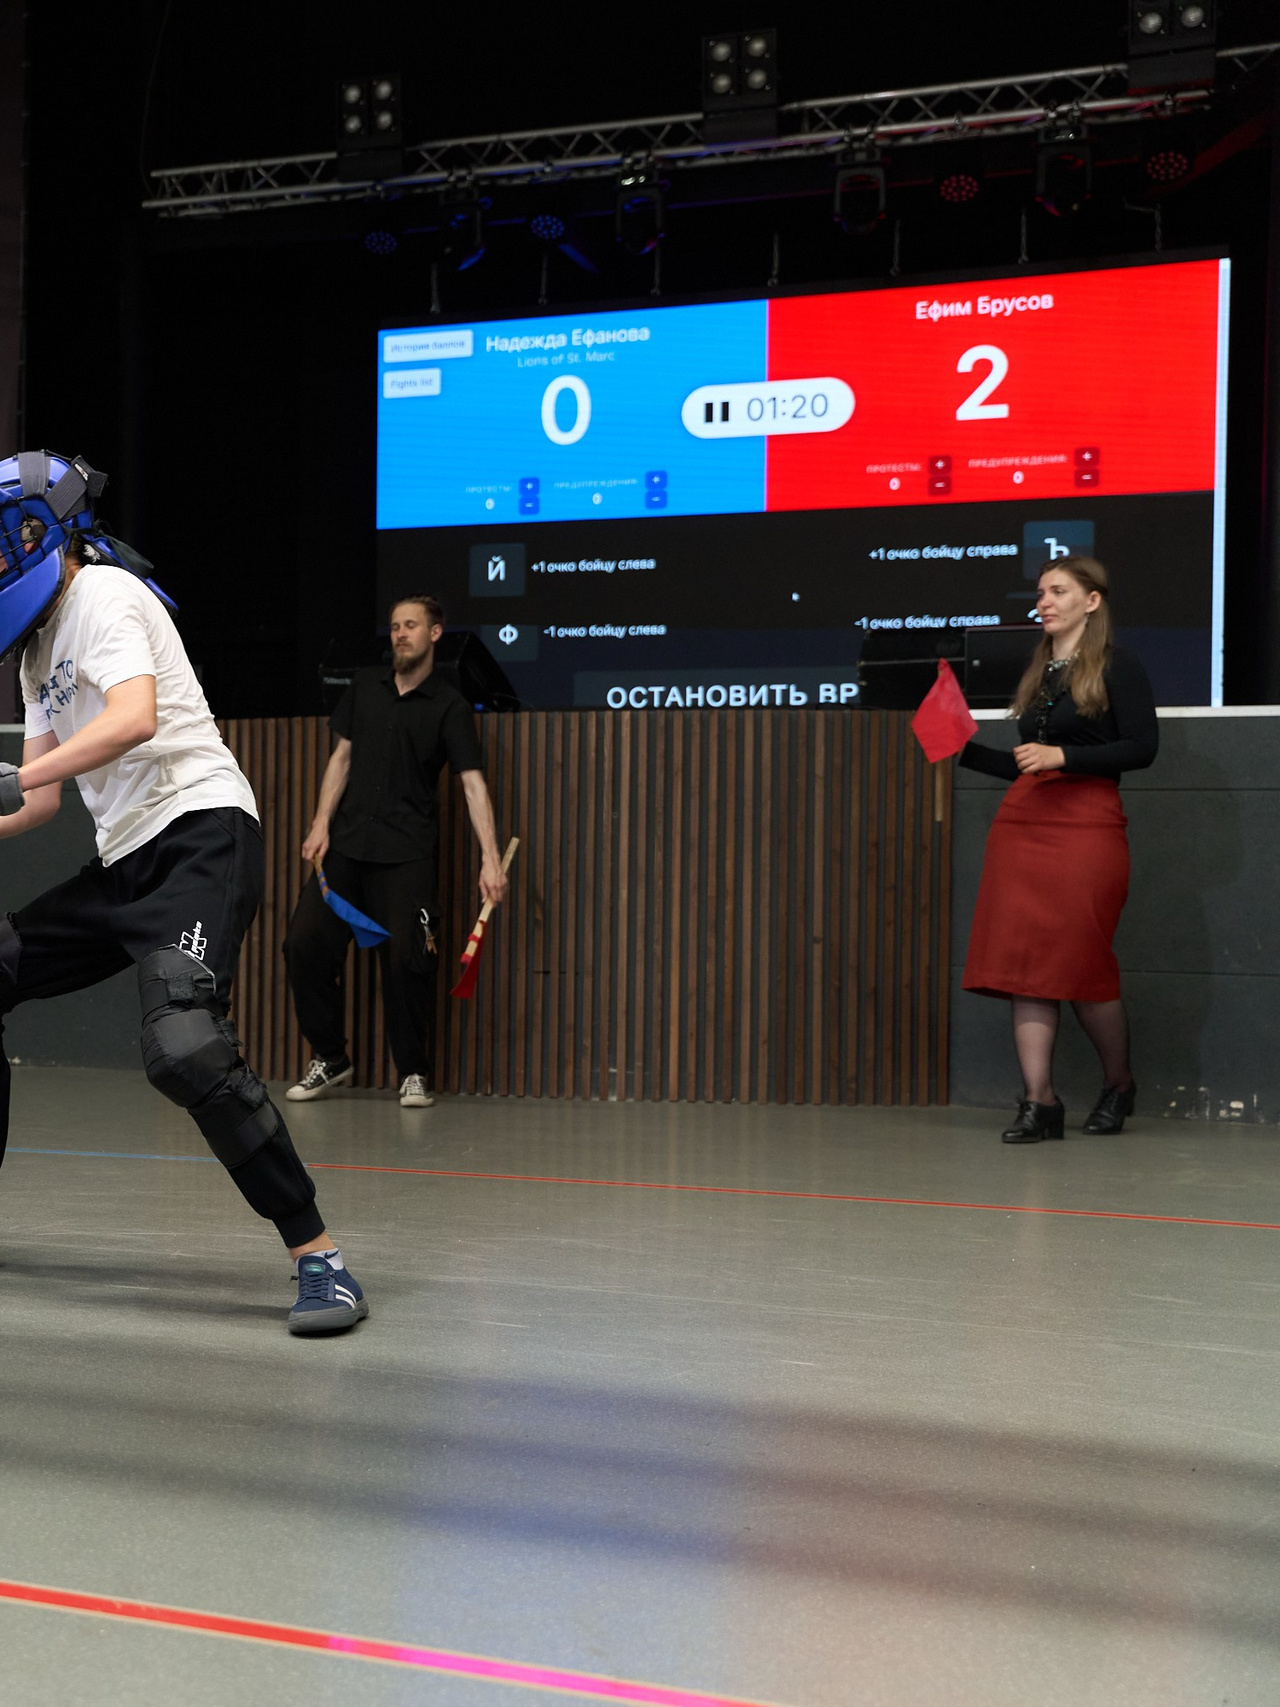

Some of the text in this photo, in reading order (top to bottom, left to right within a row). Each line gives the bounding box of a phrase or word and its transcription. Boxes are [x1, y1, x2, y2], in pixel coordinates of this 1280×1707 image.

[916, 293, 1054, 322] Ефим Брусов
[486, 326, 651, 353] Надежда Ефанова
[517, 351, 615, 368] Lions of St. Marc
[955, 344, 1009, 421] 2
[540, 375, 592, 446] 0
[747, 392, 829, 423] 01:20
[889, 477, 901, 491] 0
[1012, 471, 1024, 484] 0
[485, 498, 496, 510] 0
[592, 492, 603, 505] 0
[869, 543, 1019, 561] +1 очко бойцу справа
[487, 555, 506, 581] Й
[531, 558, 657, 573] +1 очко бойцу слева
[854, 613, 1001, 631] -1 очко бойцу справа
[544, 624, 667, 639] -1 очко бойцу слева
[606, 683, 808, 709] ОСТАНОВИТЬ
